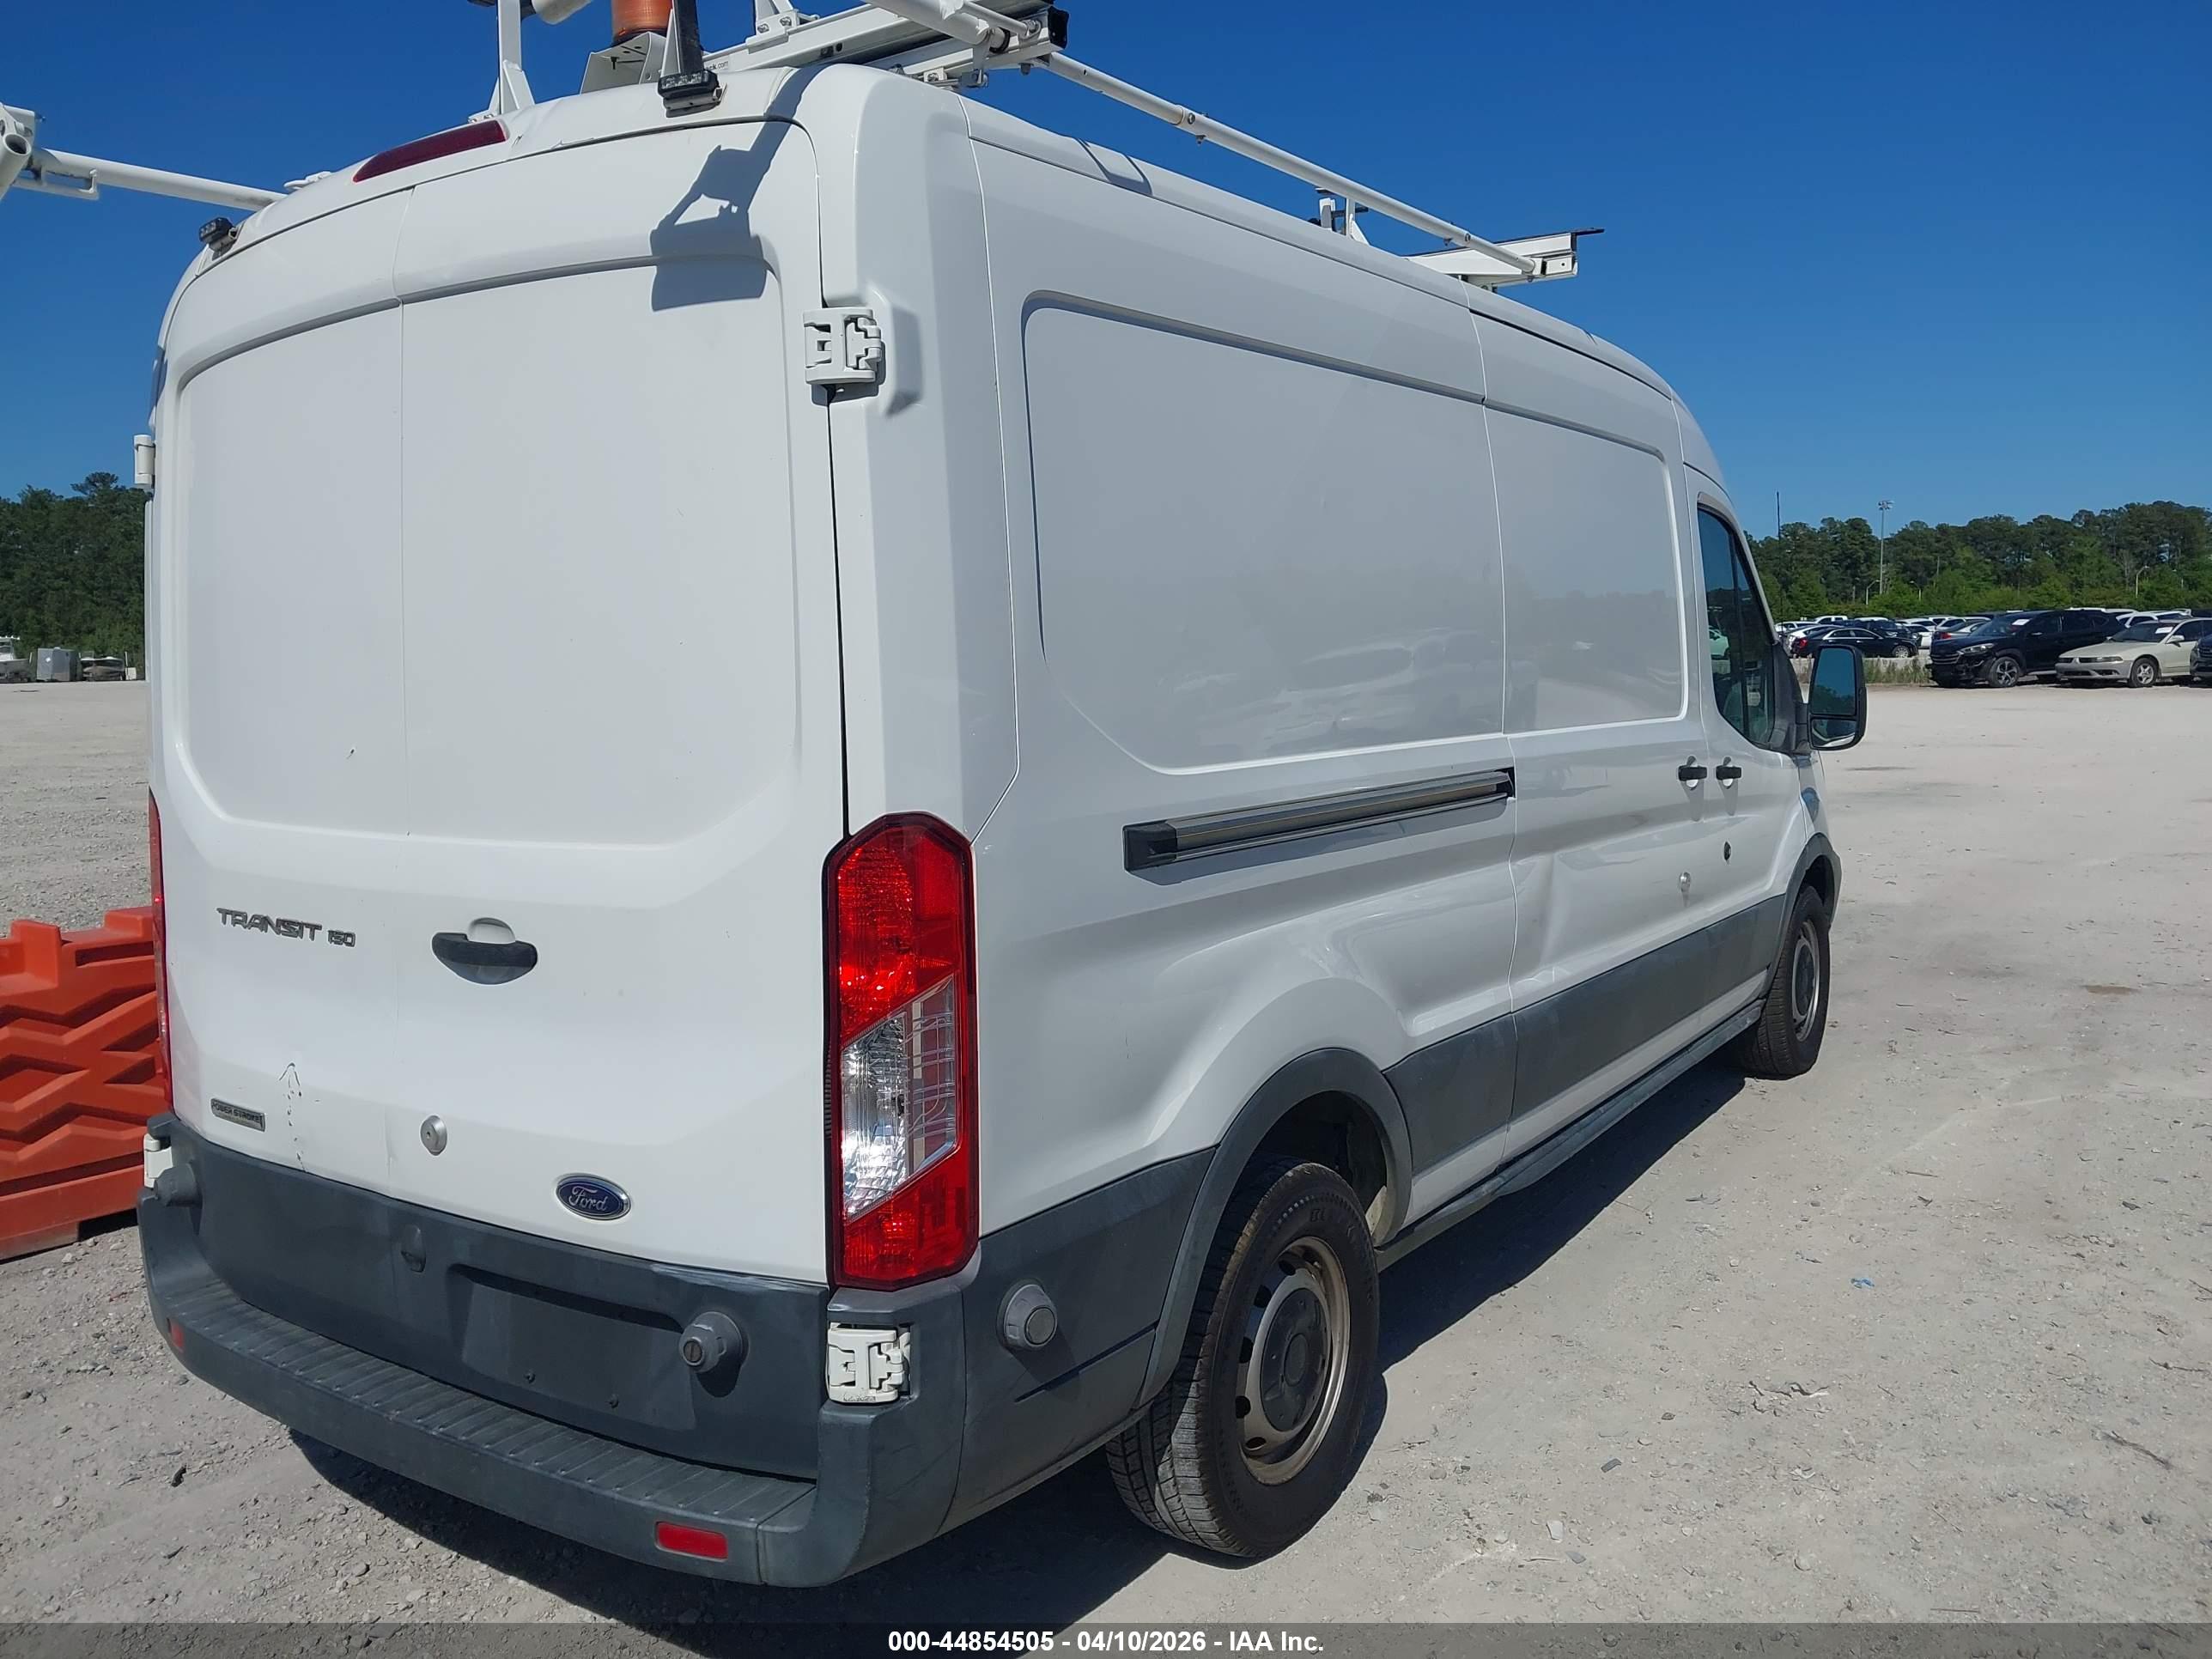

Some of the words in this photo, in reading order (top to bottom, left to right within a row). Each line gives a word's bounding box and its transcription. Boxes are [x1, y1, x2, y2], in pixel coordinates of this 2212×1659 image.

[216, 908, 323, 941] TRANSIT
[327, 930, 356, 948] 150
[568, 1185, 609, 1212] Ford
